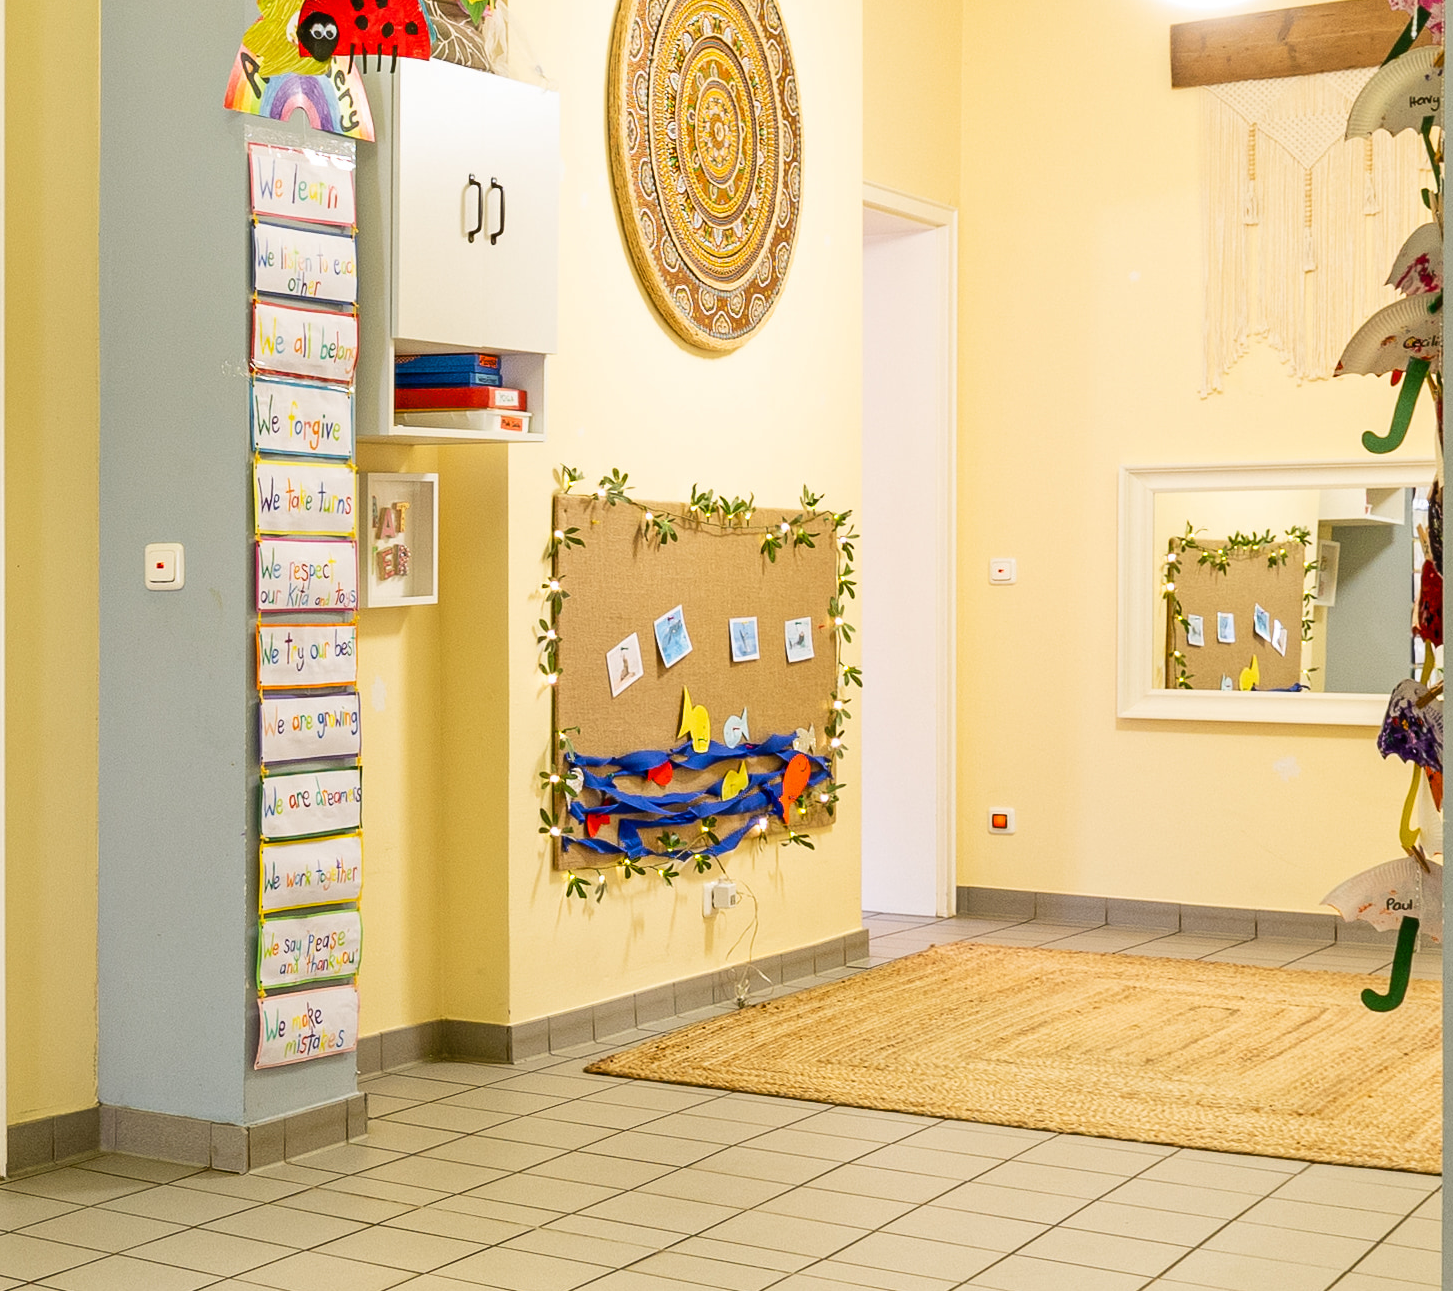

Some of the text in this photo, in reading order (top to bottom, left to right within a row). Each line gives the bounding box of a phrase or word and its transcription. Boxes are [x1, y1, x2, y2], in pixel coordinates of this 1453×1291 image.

[258, 157, 338, 209] We learn
[257, 236, 275, 268] We
[281, 243, 313, 272] listen
[317, 244, 329, 274] to
[288, 271, 321, 296] other
[258, 314, 357, 374] We all belong
[255, 394, 341, 450] We forgive
[258, 476, 352, 515] We take turns
[260, 547, 336, 590] We respect
[260, 581, 357, 607] our Kita and toys
[260, 628, 356, 672] We try our best
[263, 705, 359, 739] We are growing
[263, 775, 362, 818] We are dreamers
[264, 858, 358, 893] We work together
[1386, 897, 1413, 911] Paul
[262, 931, 279, 959] We
[284, 938, 302, 960] say
[280, 954, 299, 975] and
[264, 1001, 323, 1042] We make
[284, 1026, 345, 1058] mistakes
